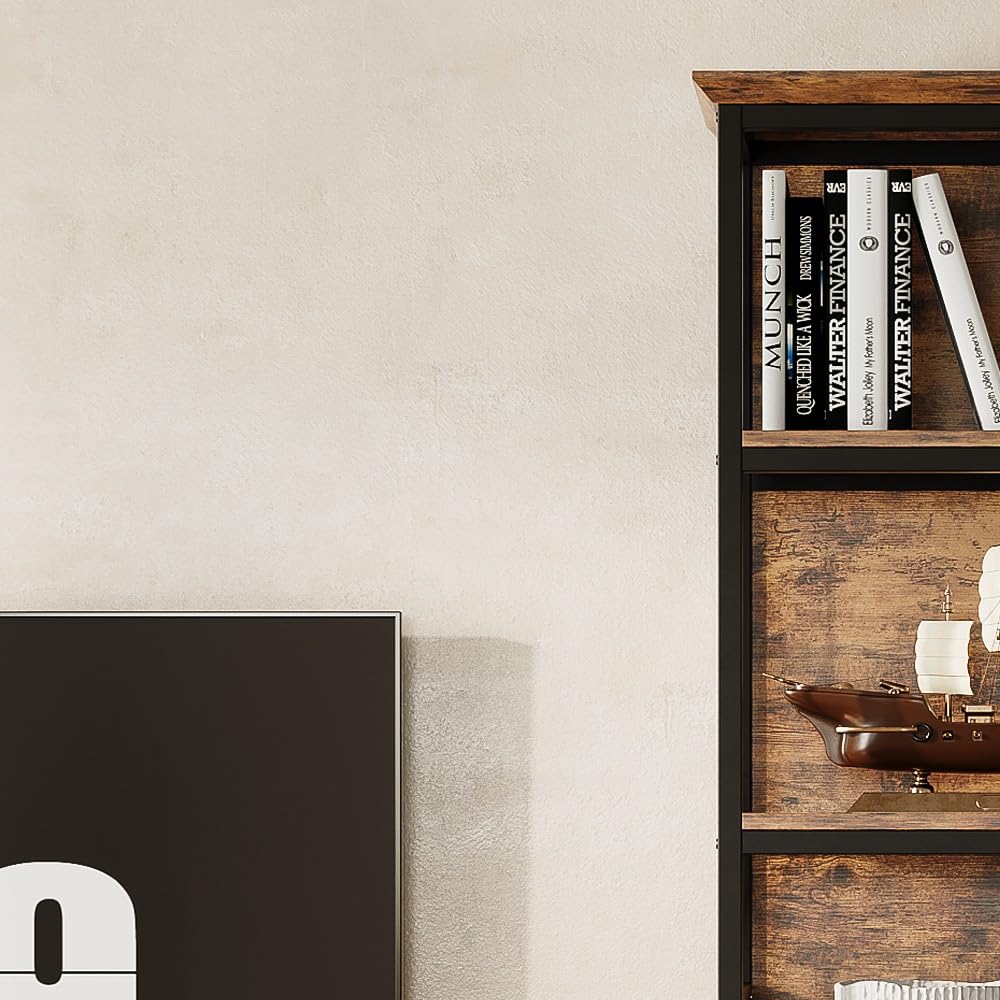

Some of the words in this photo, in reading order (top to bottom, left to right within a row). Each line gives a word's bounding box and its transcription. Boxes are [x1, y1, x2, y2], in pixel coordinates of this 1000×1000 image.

[799, 216, 812, 255] SIMMONS
[799, 254, 812, 281] DREW
[828, 213, 846, 315] FINANCE
[894, 213, 911, 315] FINANCE
[764, 236, 782, 371] MUNCH
[796, 294, 812, 323] WICK
[796, 325, 812, 334] A
[864, 317, 874, 335] Moon
[965, 318, 977, 336] Moon
[796, 335, 812, 356] LIKE
[864, 335, 874, 358] Father's
[971, 336, 985, 358] Father's
[828, 318, 846, 411] WALTER
[864, 359, 875, 368] My
[894, 318, 912, 411] WALTER
[977, 358, 987, 368] My
[796, 358, 815, 415] QUENCHED
[862, 370, 876, 393] Jolley
[980, 370, 996, 391] Jolley
[862, 393, 875, 426] Elizabeth
